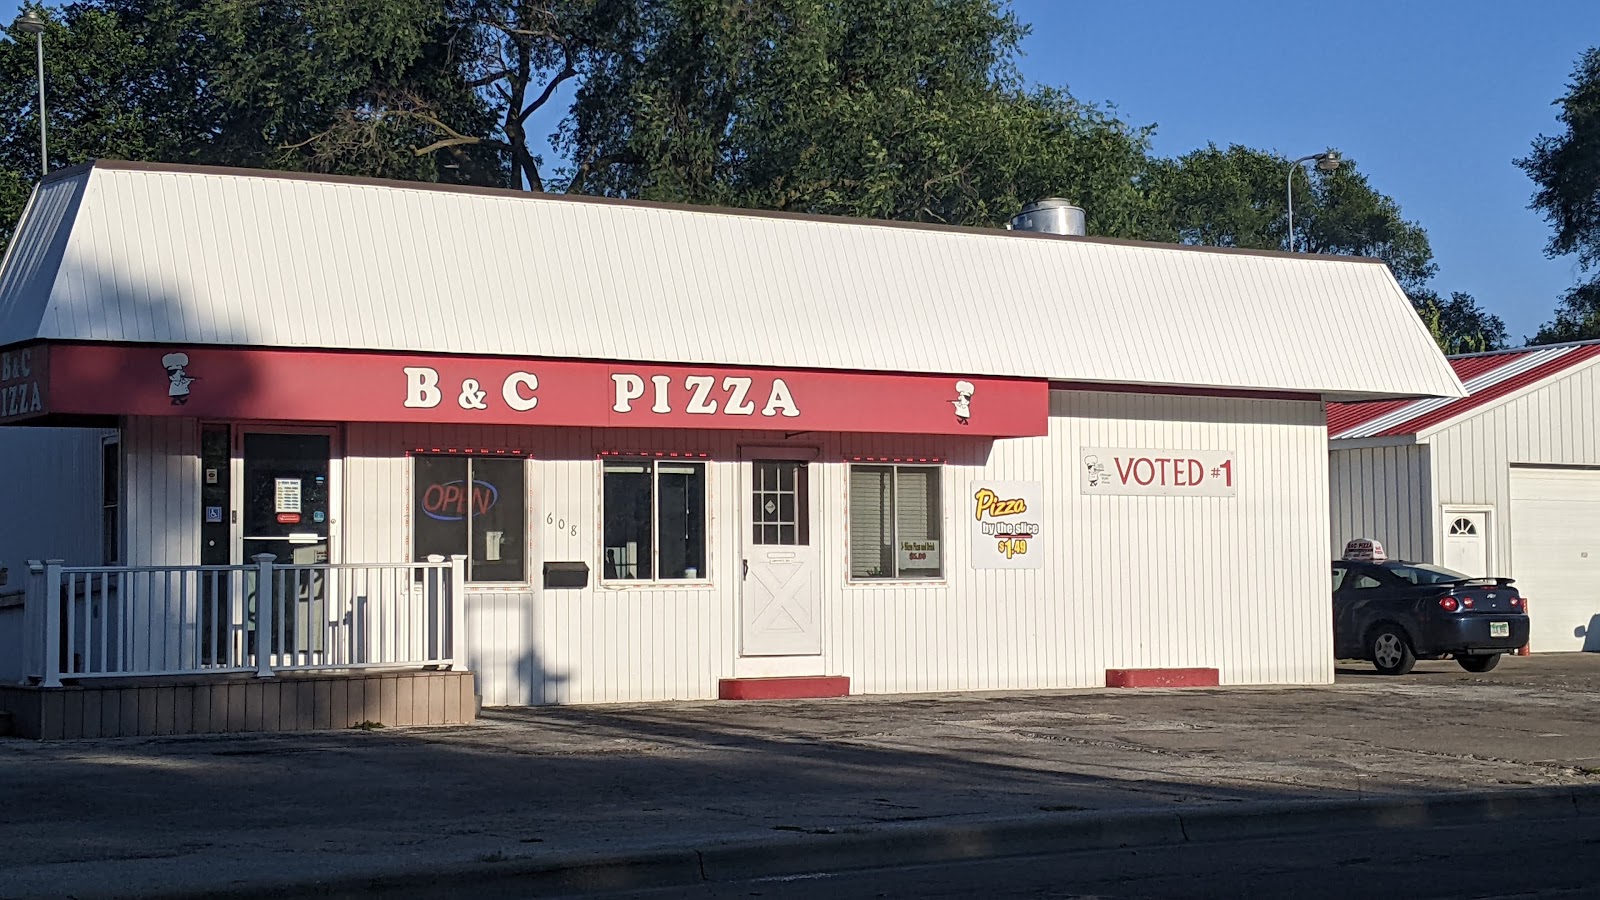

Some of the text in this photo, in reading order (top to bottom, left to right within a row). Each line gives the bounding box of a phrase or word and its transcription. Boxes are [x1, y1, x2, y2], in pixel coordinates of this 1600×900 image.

[1, 381, 42, 417] IZZA
[611, 373, 801, 417] PIZZA
[1113, 457, 1232, 487] VOTED #1
[974, 487, 1027, 521] Pizza
[982, 521, 1039, 535] by the slice
[998, 537, 1027, 559] $1.49
